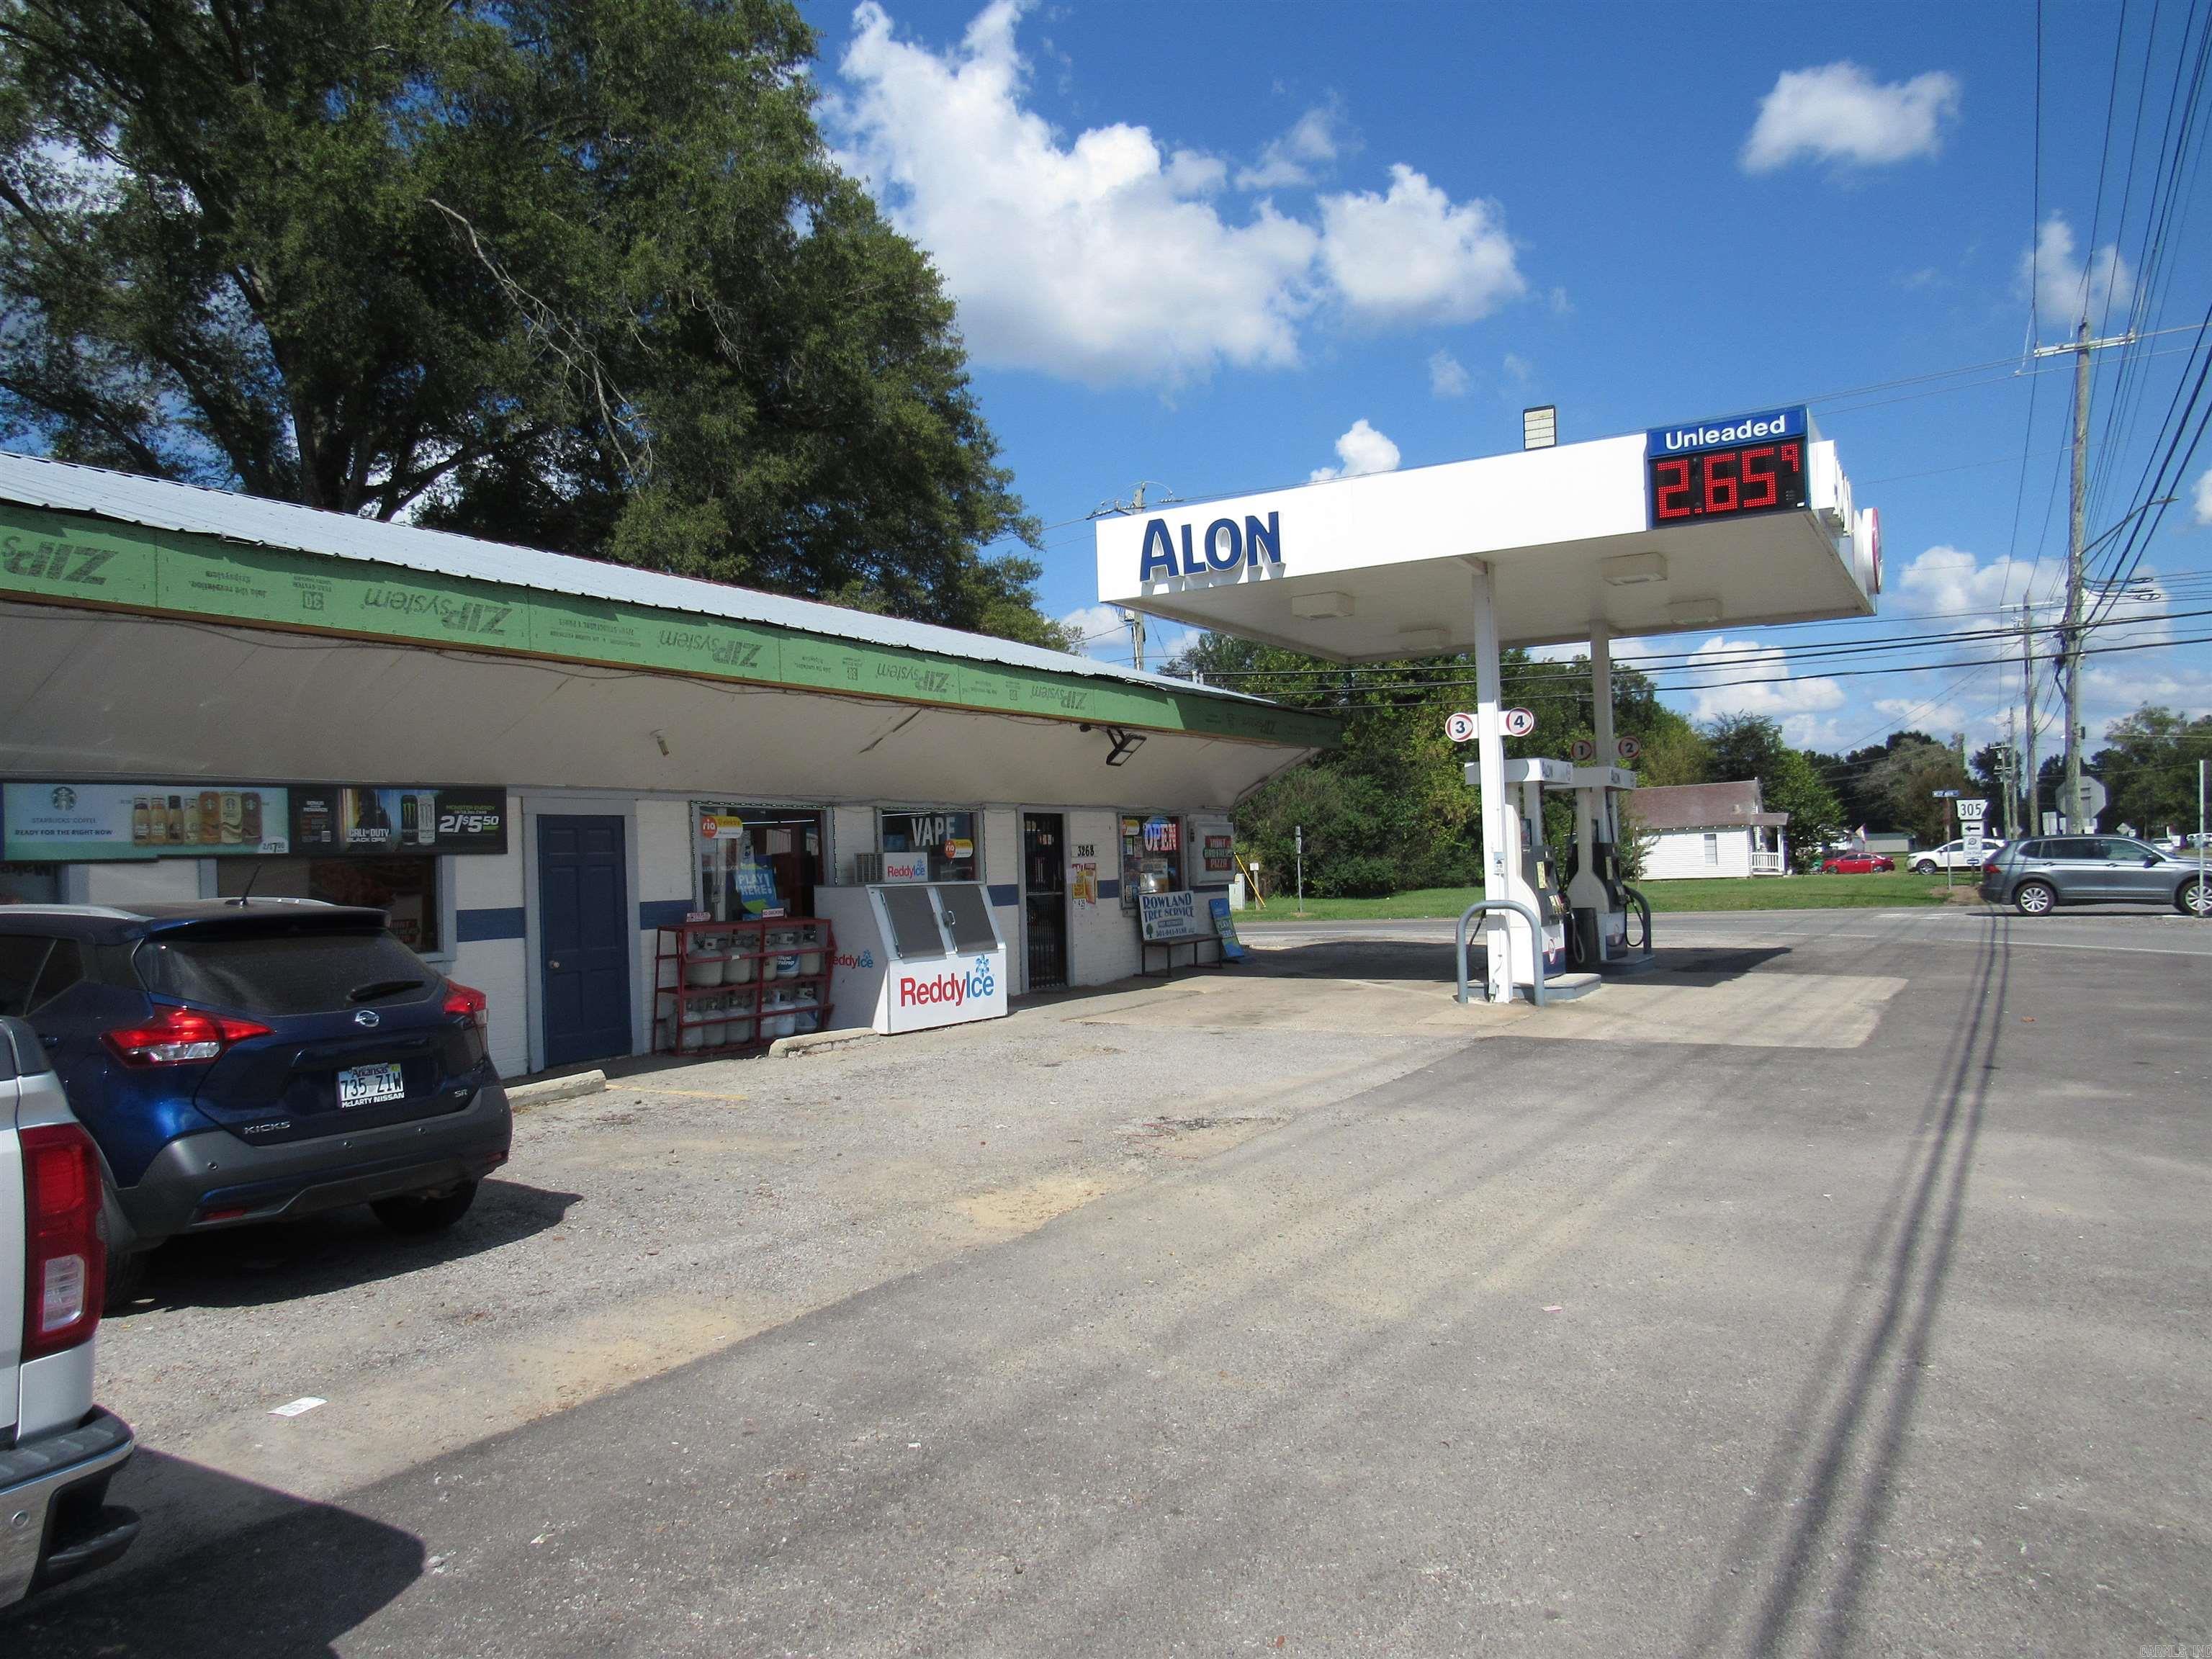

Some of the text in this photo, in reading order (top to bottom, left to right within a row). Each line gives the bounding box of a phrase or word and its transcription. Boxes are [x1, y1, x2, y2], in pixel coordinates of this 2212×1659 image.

[1665, 415, 1786, 450] Unleaded
[1140, 511, 1281, 583] ALON
[1455, 720, 1465, 733] 3
[1514, 715, 1524, 728] 4
[1578, 745, 1584, 755] 1
[1625, 742, 1634, 754] 2
[1961, 803, 1982, 817] 305
[703, 819, 716, 830] rio
[349, 828, 366, 837] CALL
[370, 828, 390, 837] DUTY
[1143, 823, 1177, 852] OPEN
[1077, 845, 1094, 857] 3268
[1143, 893, 1192, 910] ROWLAND
[341, 1077, 367, 1098] 735
[454, 1089, 467, 1097] SR
[374, 1092, 405, 1103] NISSAN
[243, 1120, 291, 1135] KICKS
